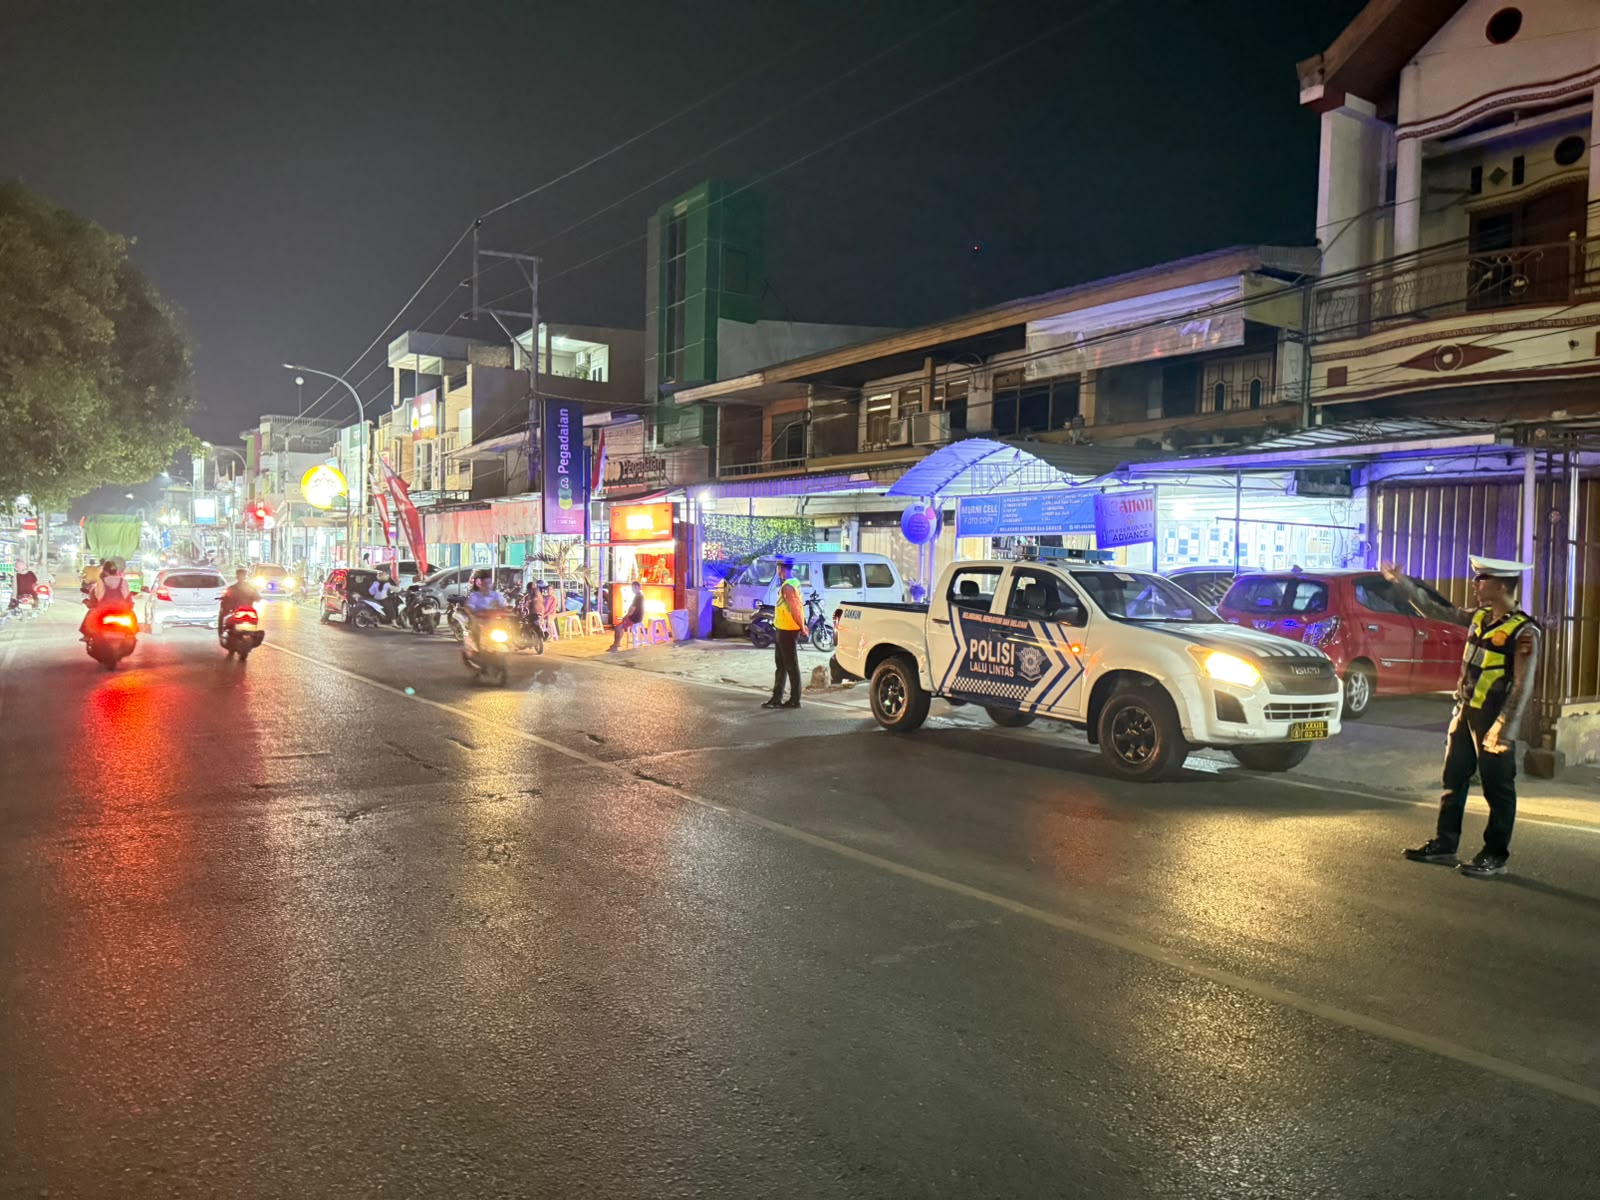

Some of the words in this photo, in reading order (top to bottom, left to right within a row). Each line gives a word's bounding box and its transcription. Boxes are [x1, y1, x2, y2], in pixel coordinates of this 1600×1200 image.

[558, 408, 572, 474] Pegadaian
[960, 505, 982, 514] MURNI
[983, 504, 998, 514] CELL
[964, 517, 978, 525] FOTO
[978, 516, 993, 525] COPY
[1112, 529, 1149, 543] ADVANCE
[969, 638, 1016, 665] POLISI
[969, 661, 987, 674] LALU
[988, 664, 1015, 678] LINTAS
[1293, 665, 1320, 675] ISUZU
